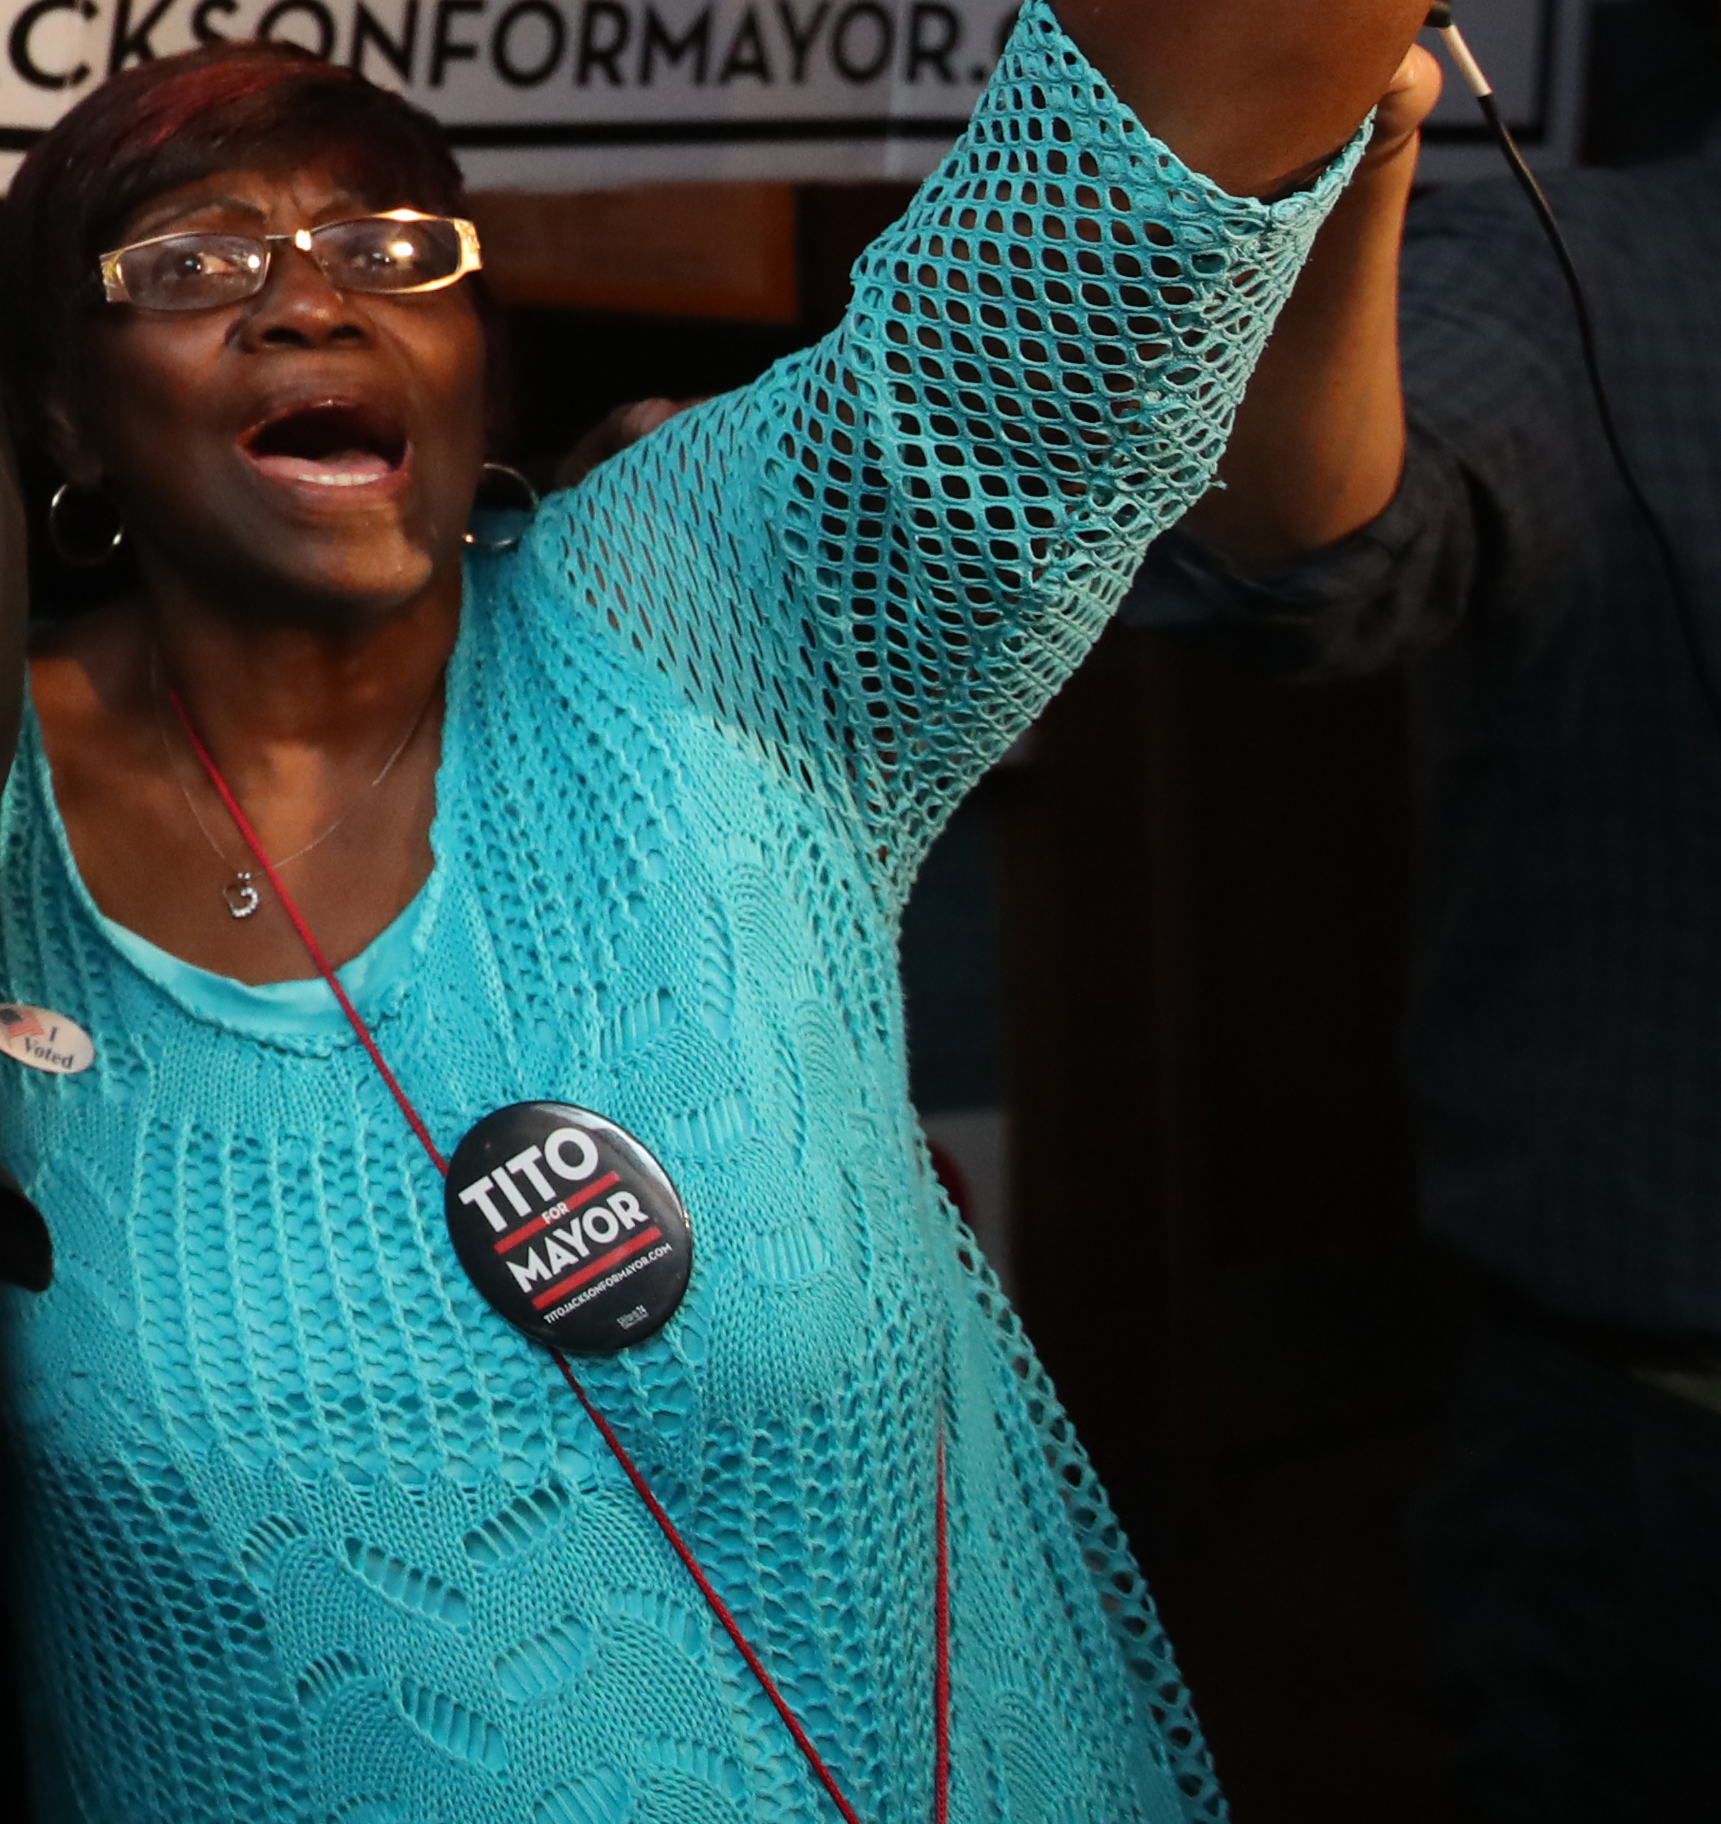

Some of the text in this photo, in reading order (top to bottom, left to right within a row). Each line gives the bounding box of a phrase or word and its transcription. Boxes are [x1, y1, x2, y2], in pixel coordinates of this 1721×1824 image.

[24, 1035, 74, 1069] Voted
[49, 1026, 57, 1042] I
[458, 1128, 599, 1232] TITO
[542, 1201, 569, 1225] FOR
[506, 1191, 649, 1293] MAYOR
[543, 1243, 673, 1324] TITOJACKSONFORMAYOR.COM
